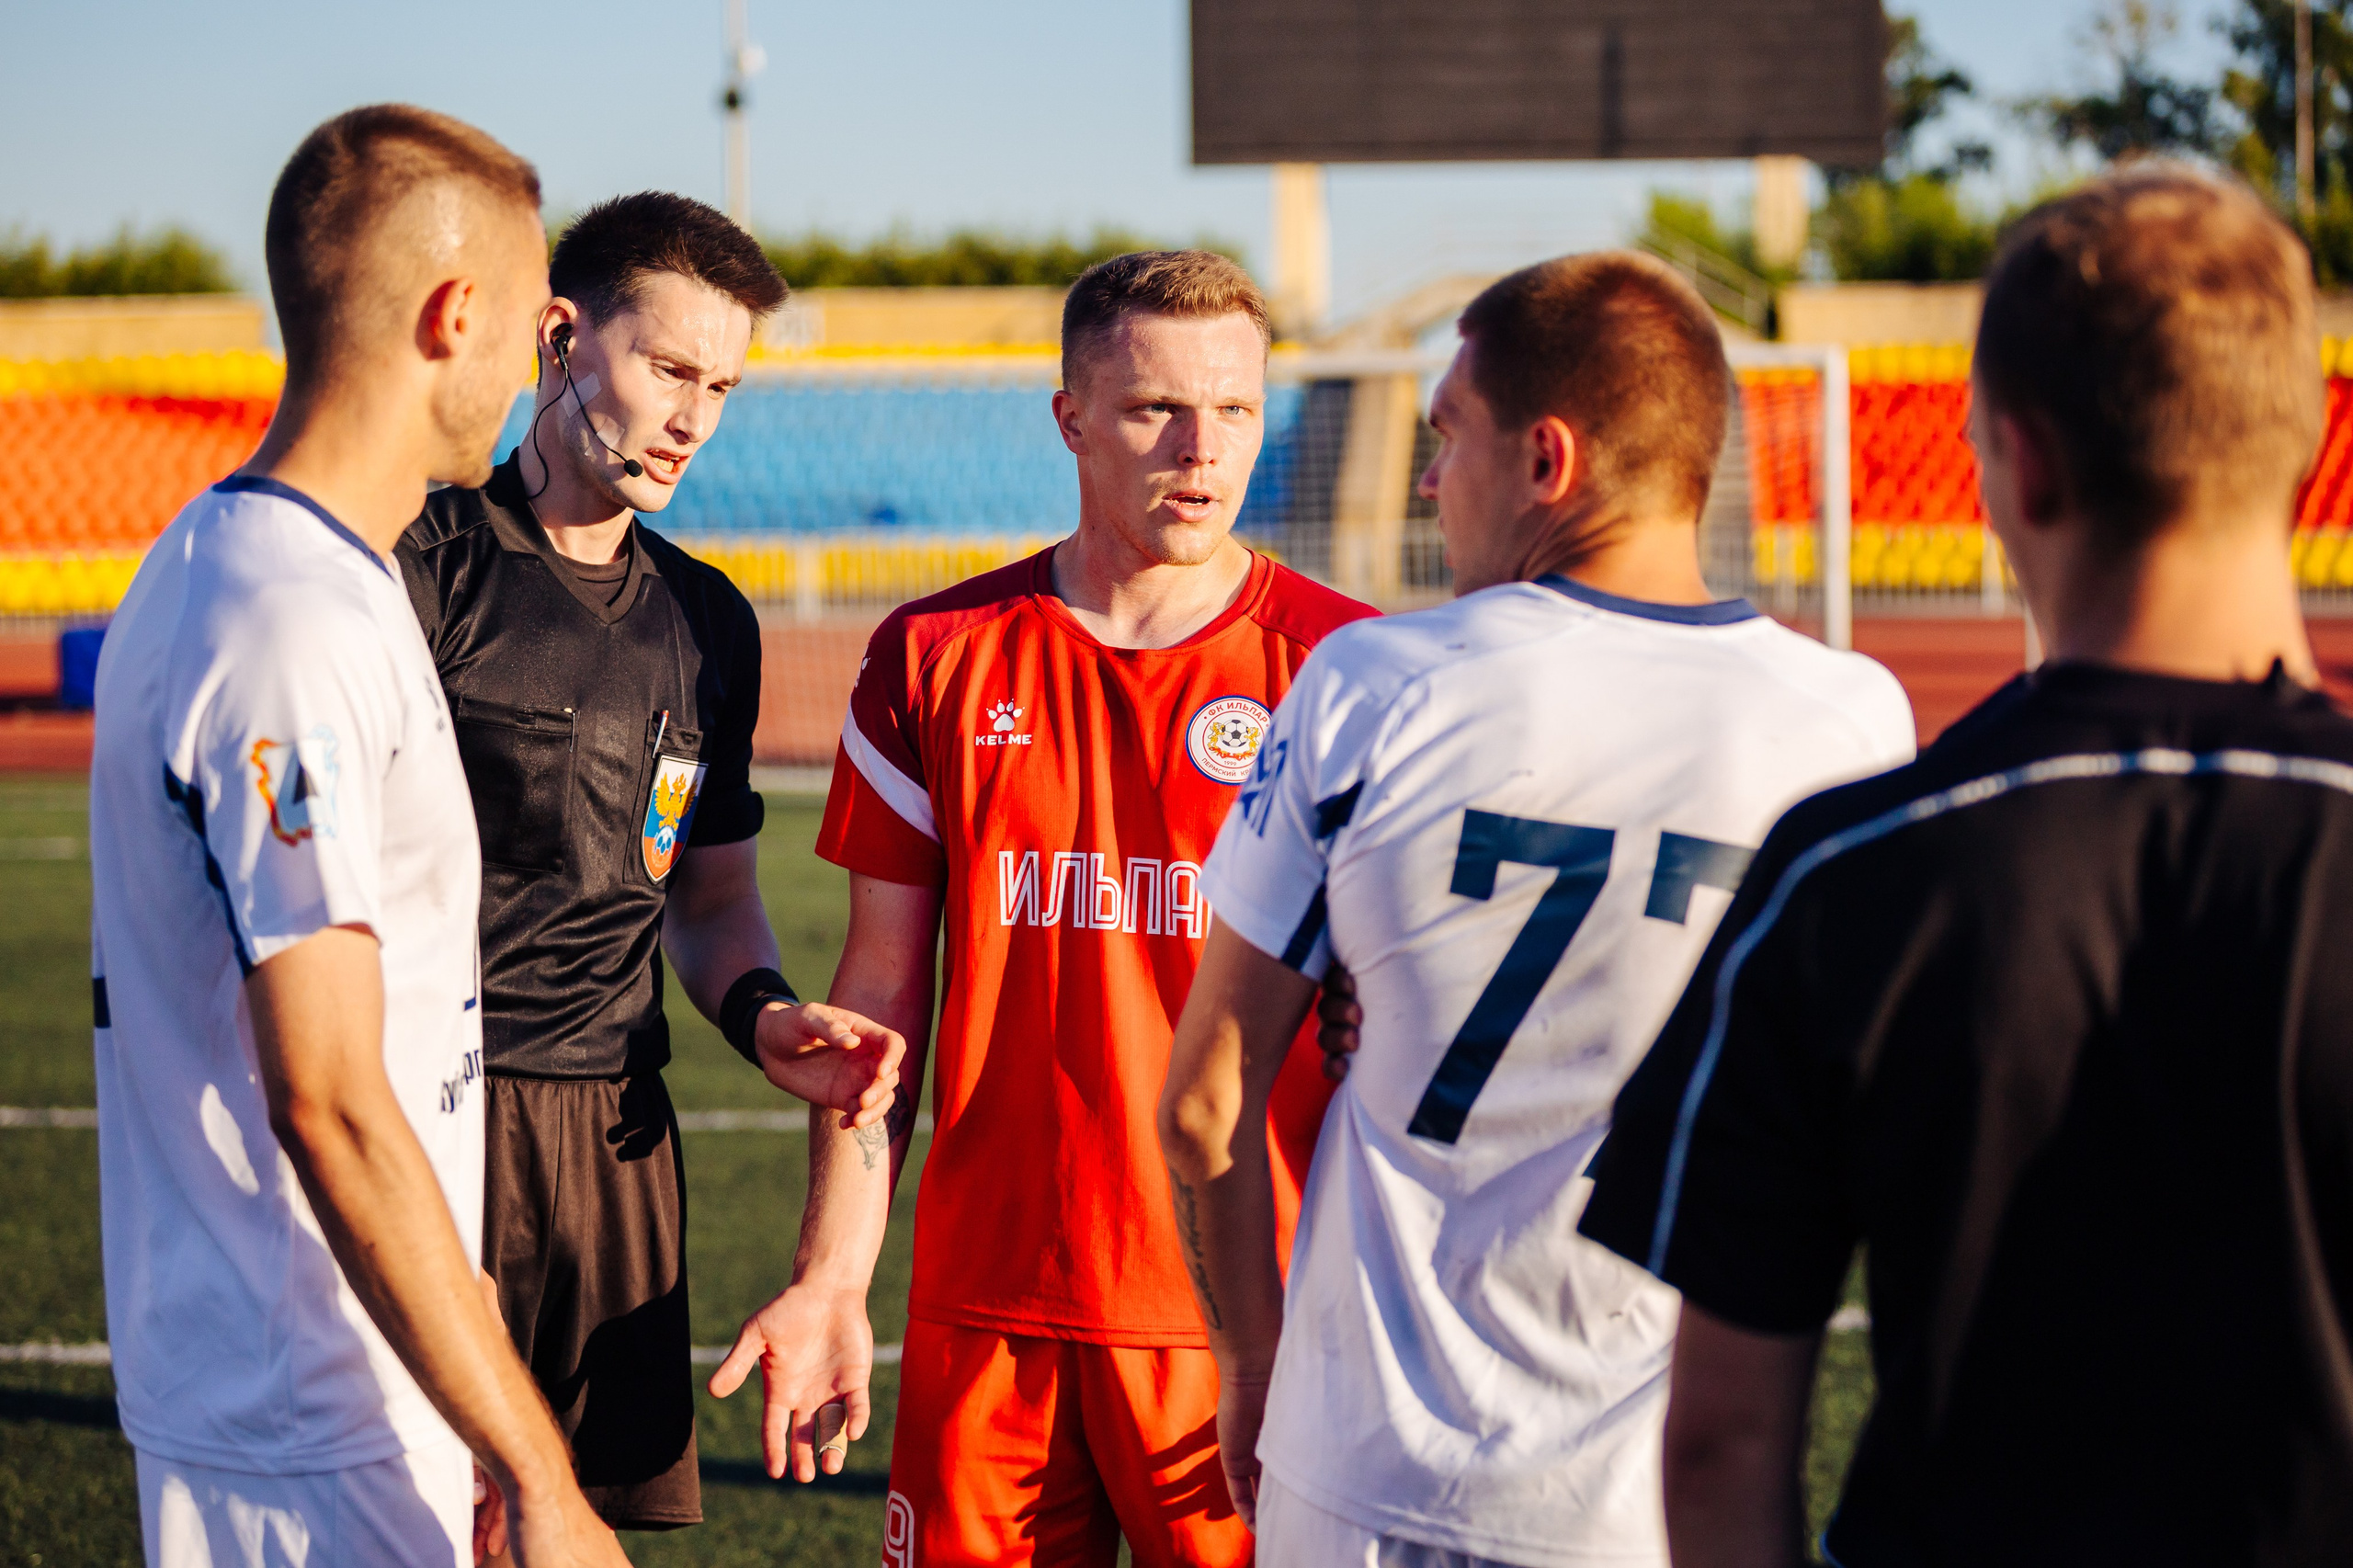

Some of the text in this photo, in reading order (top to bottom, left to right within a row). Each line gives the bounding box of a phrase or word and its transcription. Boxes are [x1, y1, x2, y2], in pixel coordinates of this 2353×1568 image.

[1208, 701, 1268, 723] ФК ИЛЬПАР
[975, 733, 1032, 746] KELME
[1201, 757, 1252, 777] ПЕРМСКИЙ КР
[998, 850, 1211, 939] ИЛЬПА
